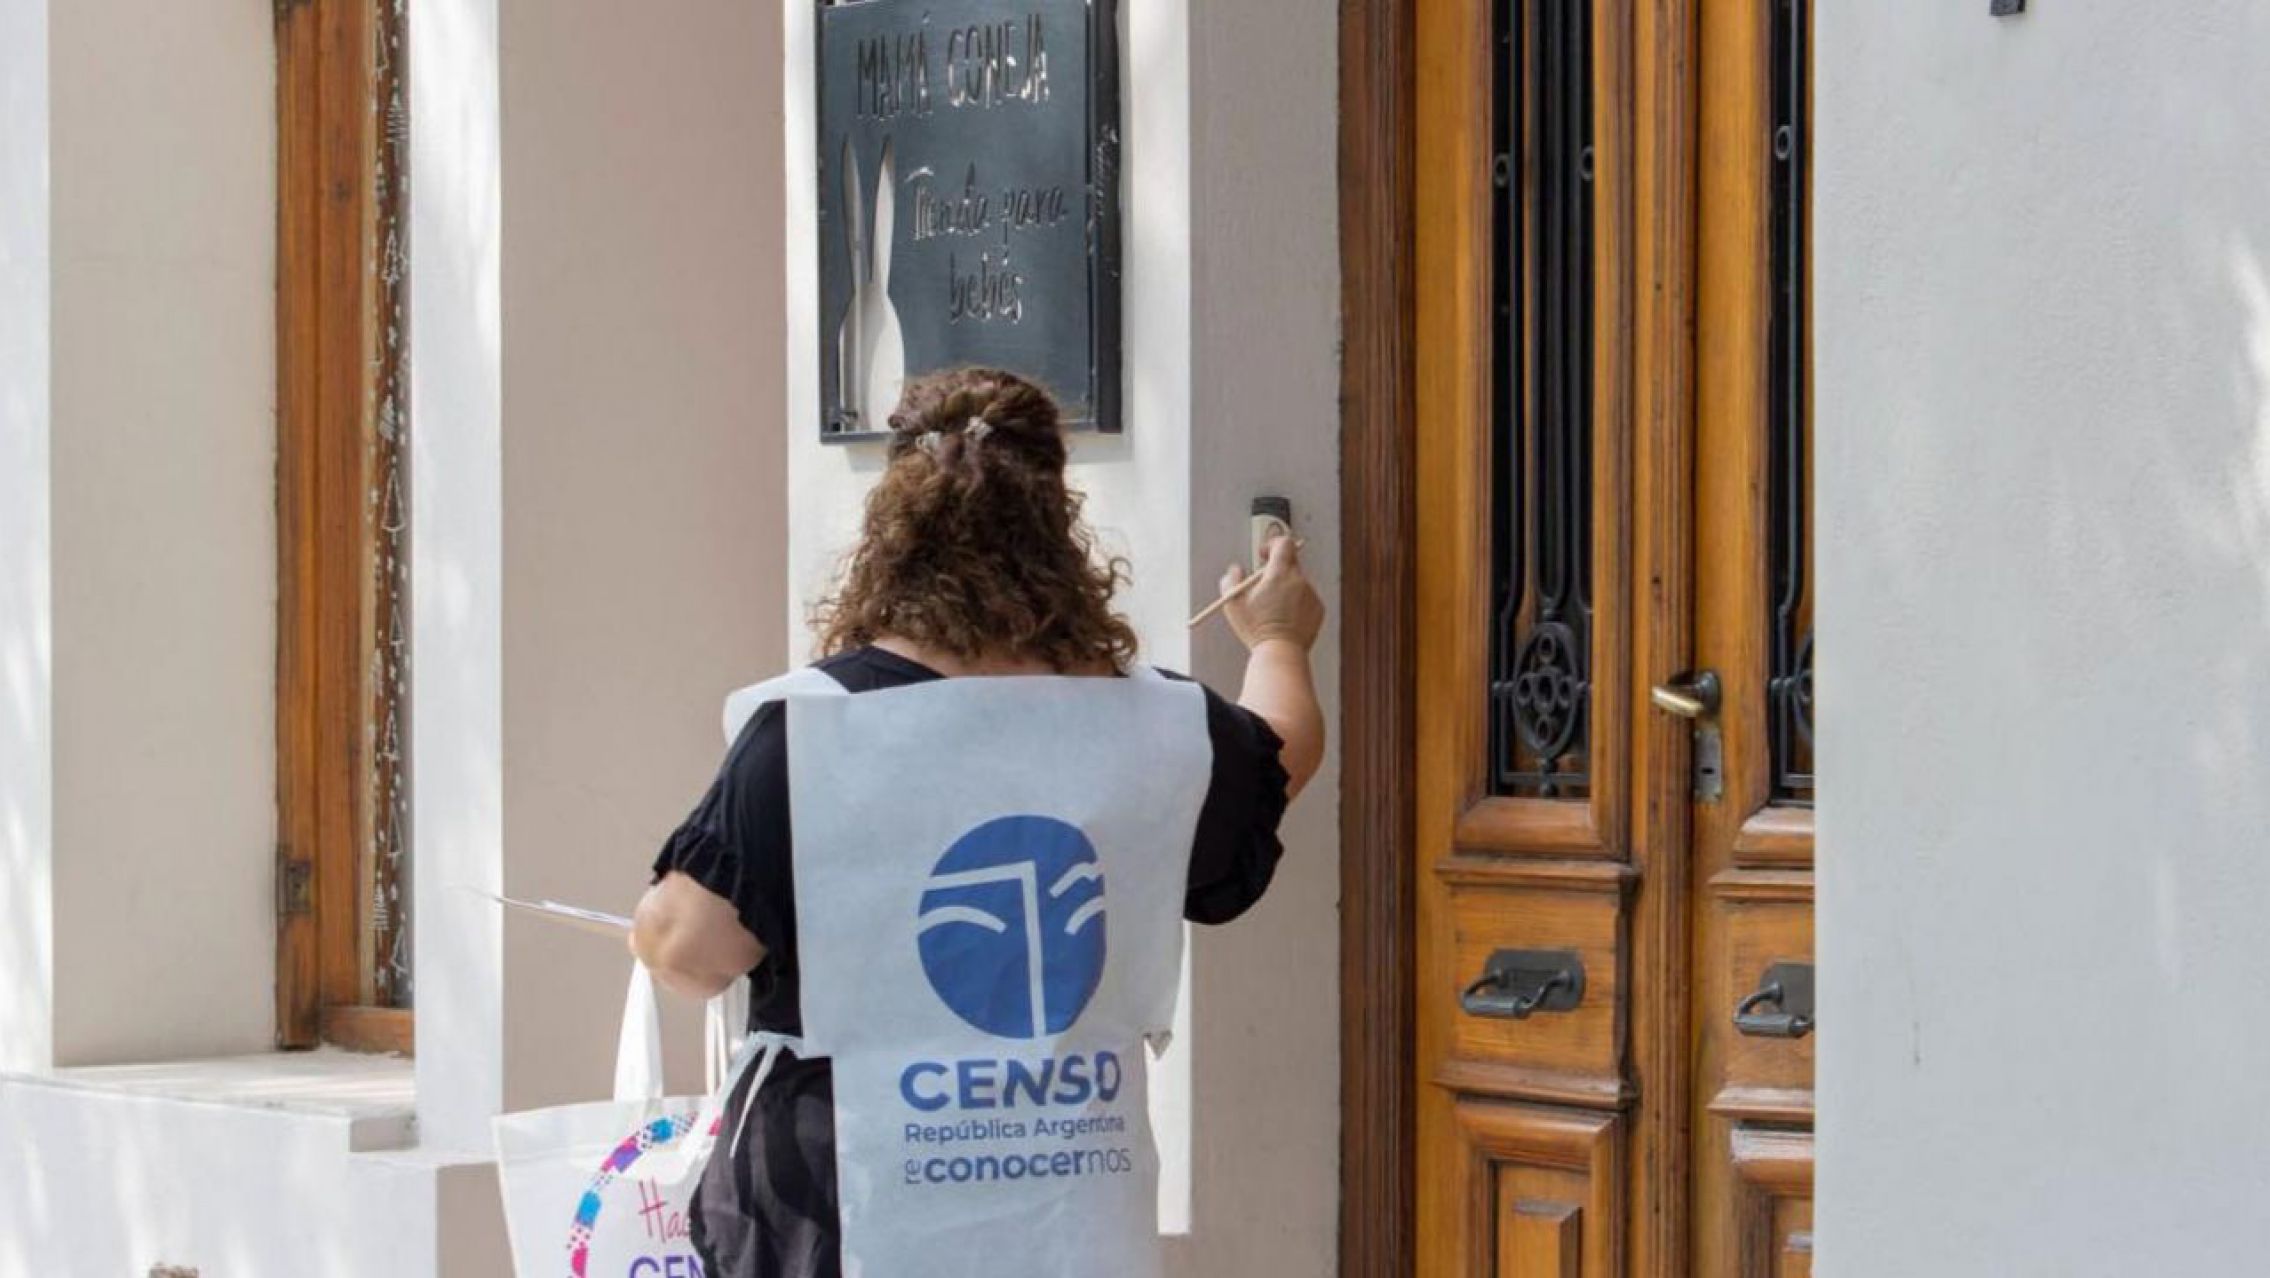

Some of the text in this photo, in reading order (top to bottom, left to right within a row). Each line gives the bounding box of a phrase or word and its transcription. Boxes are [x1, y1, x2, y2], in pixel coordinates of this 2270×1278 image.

[857, 11, 1050, 120] MAMÁ CONEJA
[904, 162, 990, 240] Tienda
[1001, 184, 1068, 246] para
[949, 251, 1024, 325] bebés
[900, 1050, 1121, 1112] CENSO
[905, 1119, 1026, 1146] República
